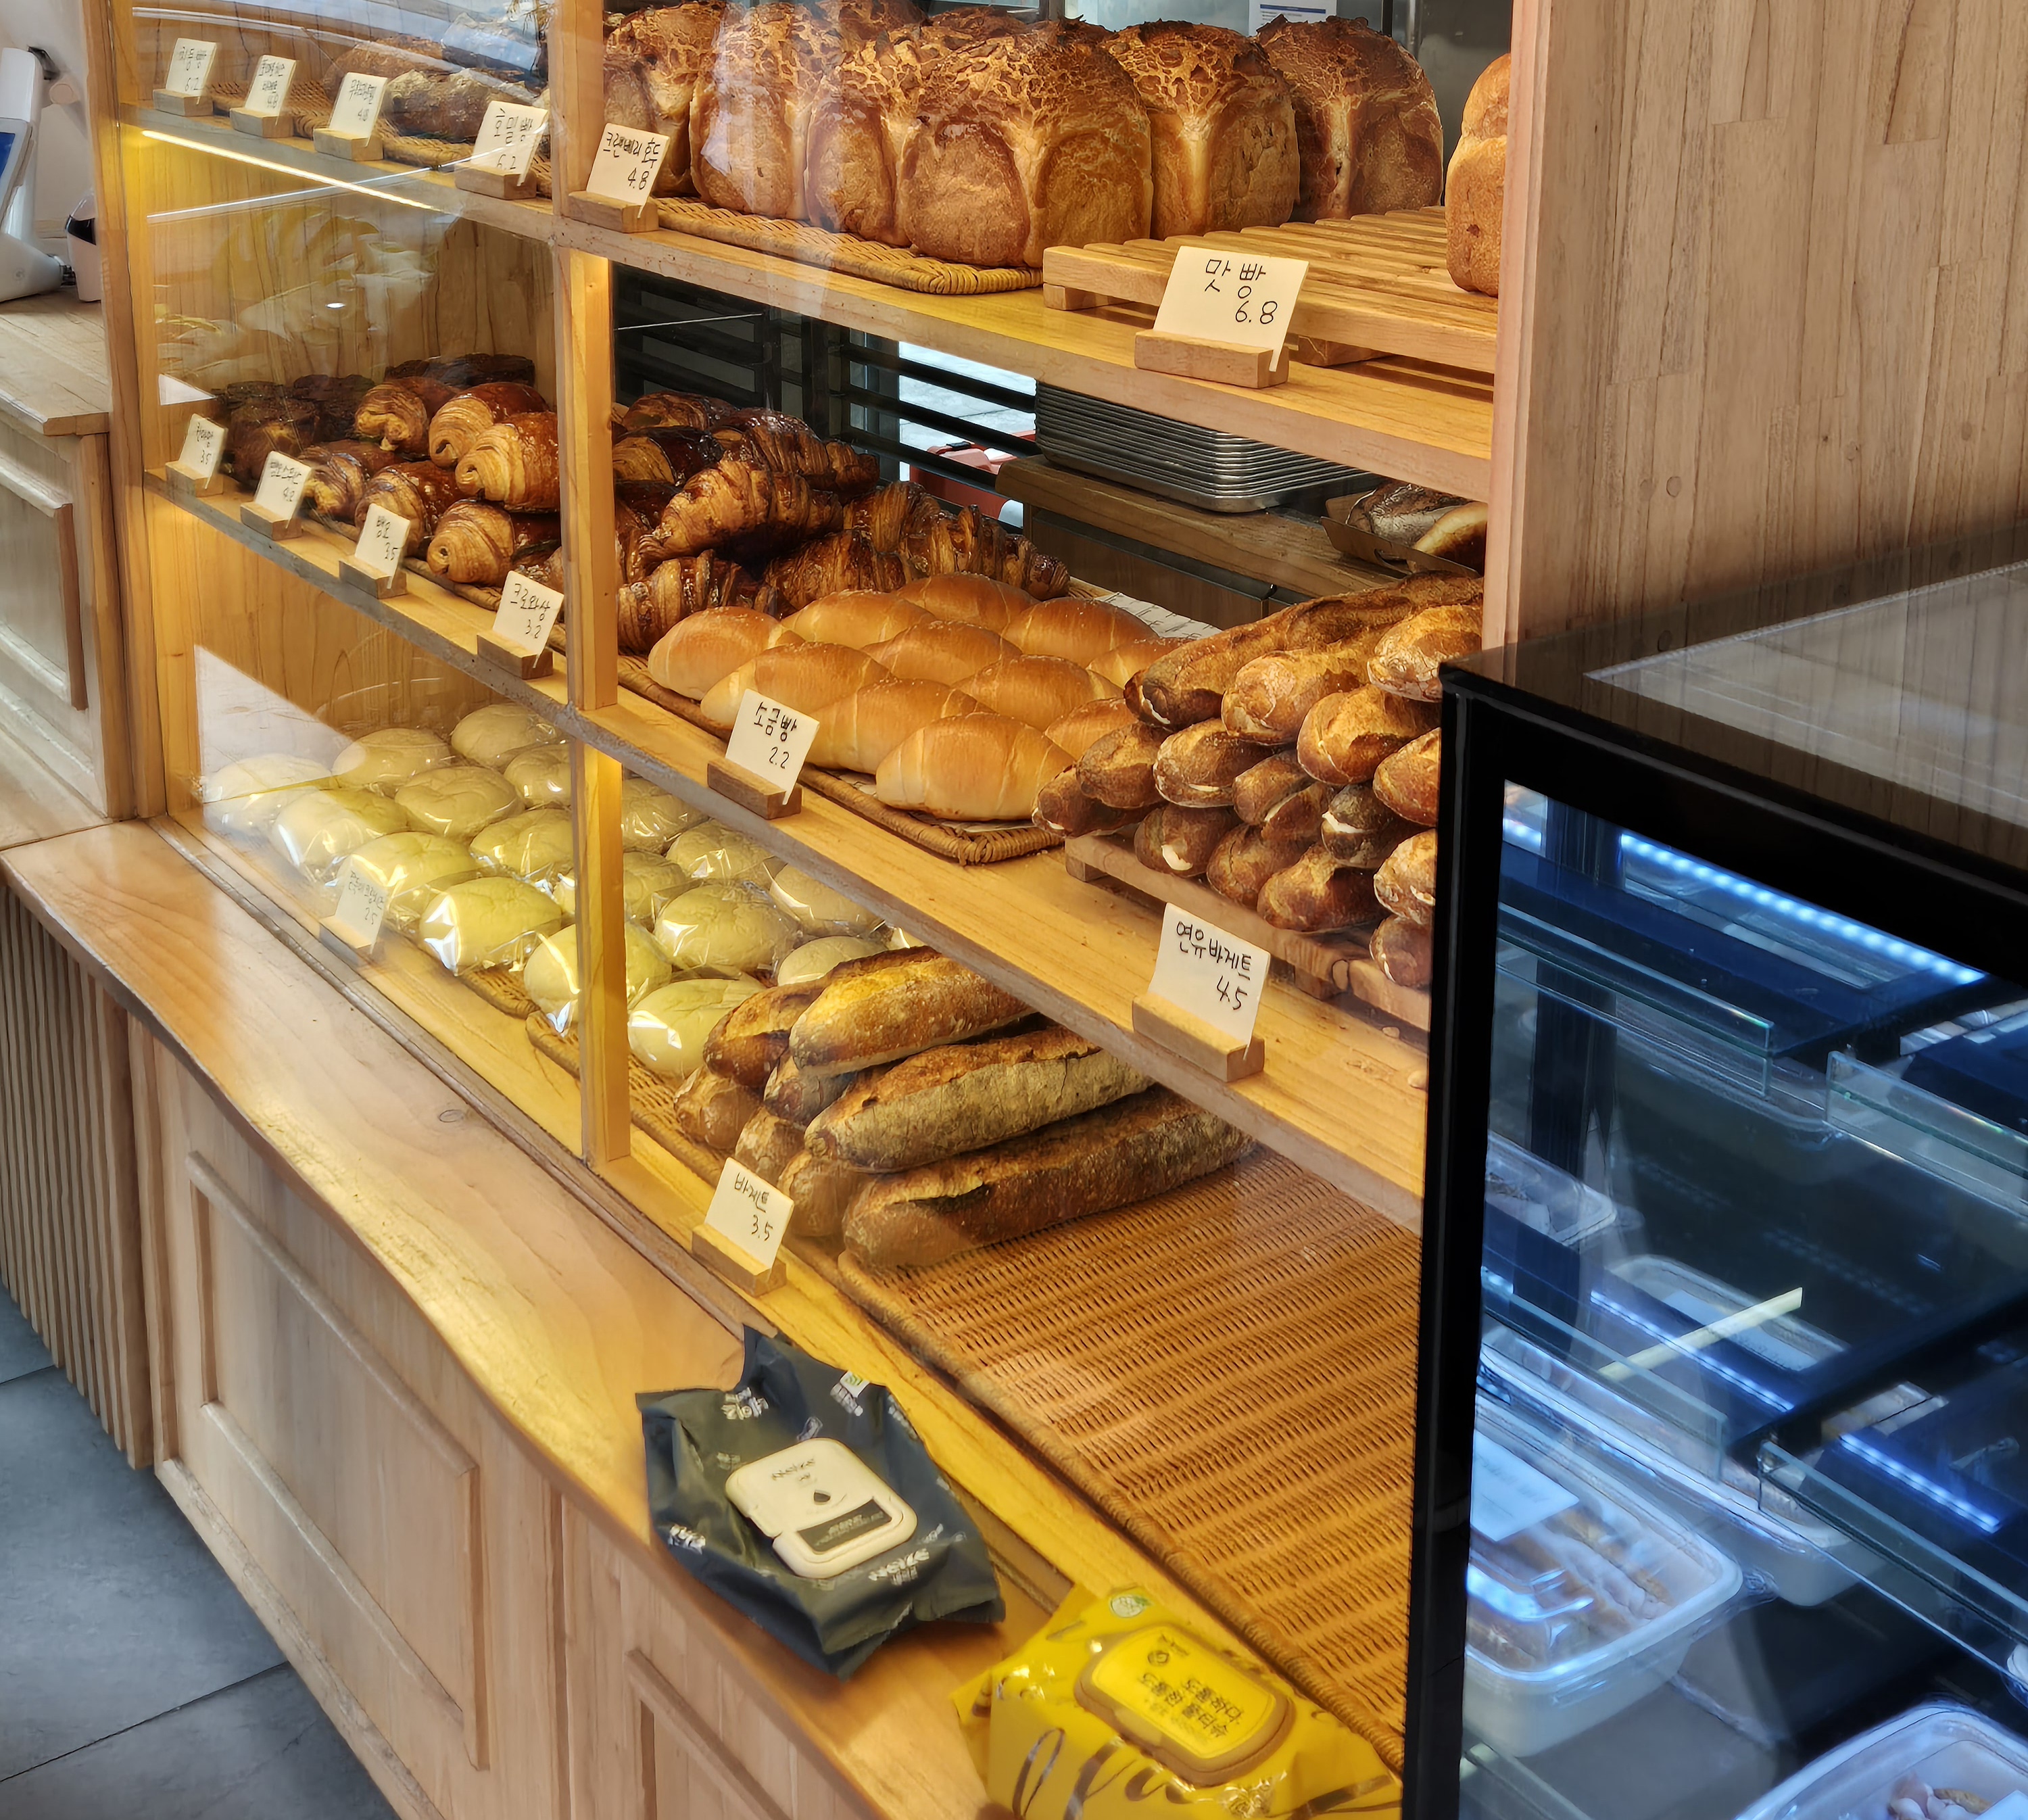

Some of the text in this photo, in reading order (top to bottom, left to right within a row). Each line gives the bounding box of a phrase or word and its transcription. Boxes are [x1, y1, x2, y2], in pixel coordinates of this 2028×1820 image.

[494, 107, 533, 145] 호밀빵
[627, 167, 650, 191] 4.8
[1234, 300, 1278, 325] 6.8
[753, 700, 798, 742] 소금빵
[769, 746, 790, 769] 2.2
[1176, 920, 1253, 981] 연유바게트
[733, 1171, 770, 1214] 바게트
[751, 1214, 774, 1242] 3.5
